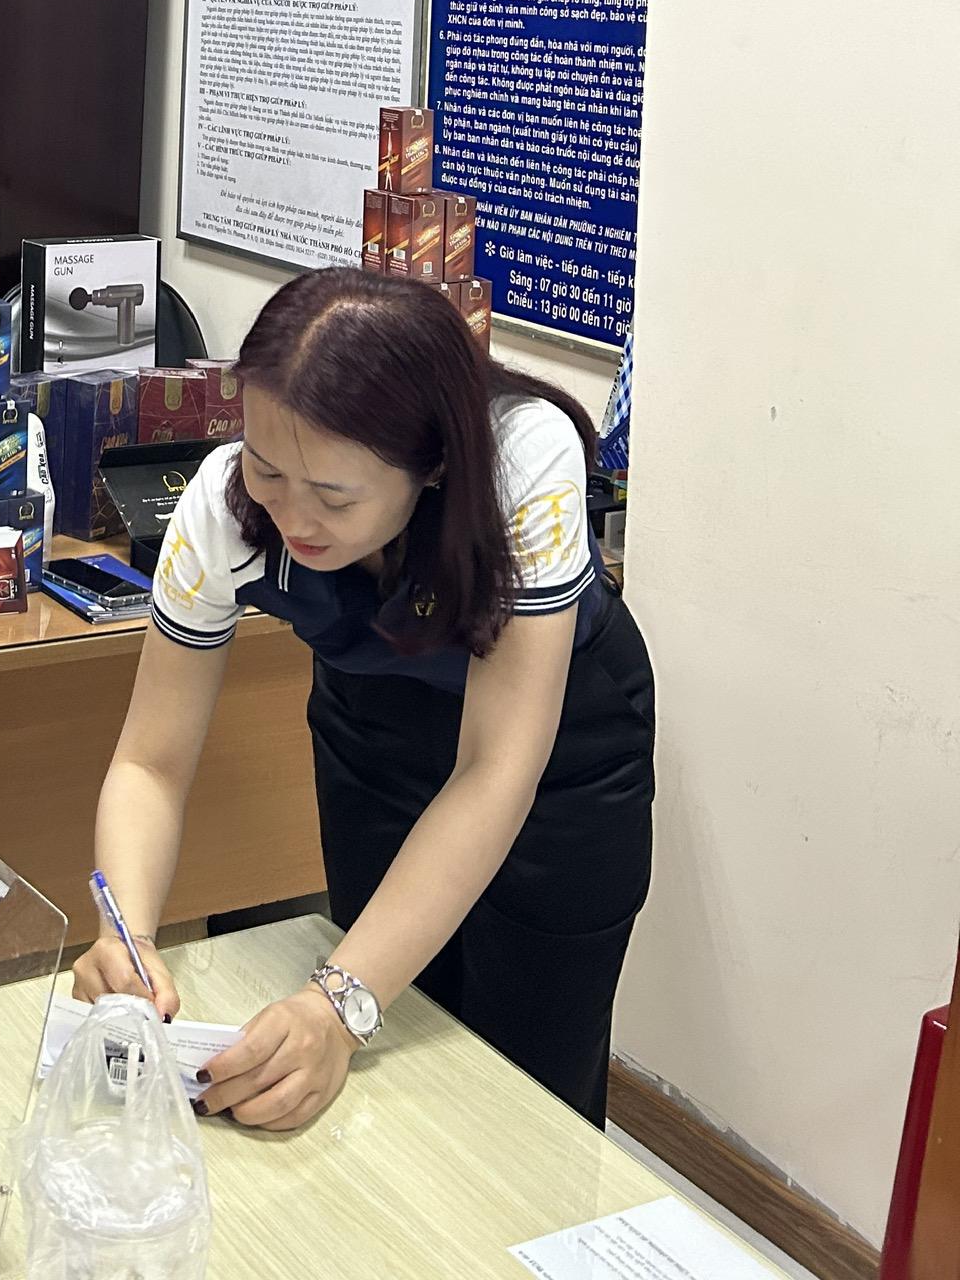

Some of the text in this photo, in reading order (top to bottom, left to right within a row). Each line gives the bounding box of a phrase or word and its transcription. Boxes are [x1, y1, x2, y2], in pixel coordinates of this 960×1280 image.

[520, 210, 532, 222] BAN
[598, 225, 603, 236] 3
[54, 254, 94, 265] MASSAGE
[54, 267, 73, 276] GUN
[500, 246, 625, 288] Giờ làm việc tiếp dân tiếp
[510, 270, 632, 314] Sáng 07 giờ 30 đến 11 giờ
[507, 290, 532, 309] Chiều
[541, 299, 550, 314] 13
[552, 303, 567, 319] giờ
[570, 306, 580, 322] 00
[582, 309, 600, 327] đến
[603, 316, 614, 330] 17
